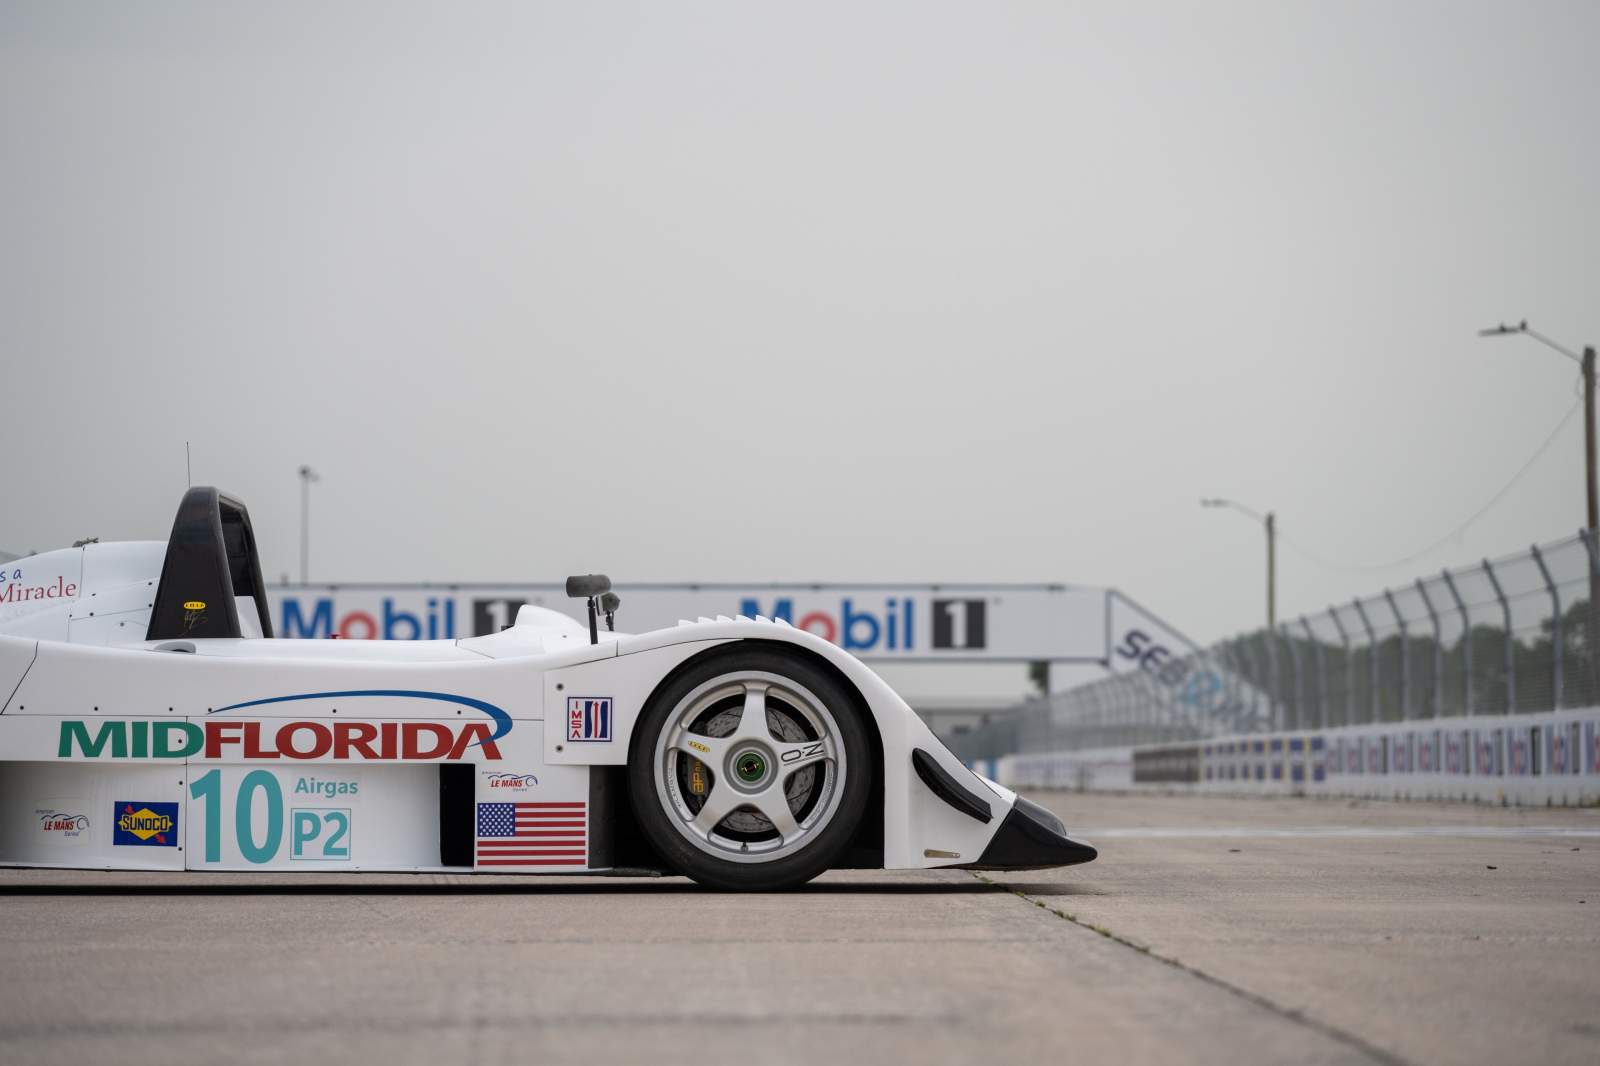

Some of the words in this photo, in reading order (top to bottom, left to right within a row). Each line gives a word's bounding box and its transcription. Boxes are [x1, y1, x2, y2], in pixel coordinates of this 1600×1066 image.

[13, 569, 22, 580] a
[281, 598, 455, 640] Mobil
[571, 701, 582, 739] IMSA
[58, 720, 502, 760] MIDFLORIDA
[295, 777, 358, 798] Airgas
[491, 780, 501, 788] LE
[502, 779, 523, 788] MANS
[43, 820, 53, 831] LE
[53, 820, 75, 831] MANS
[122, 815, 168, 831] SUNOCO
[189, 769, 284, 865] 10
[293, 810, 349, 857] P2
